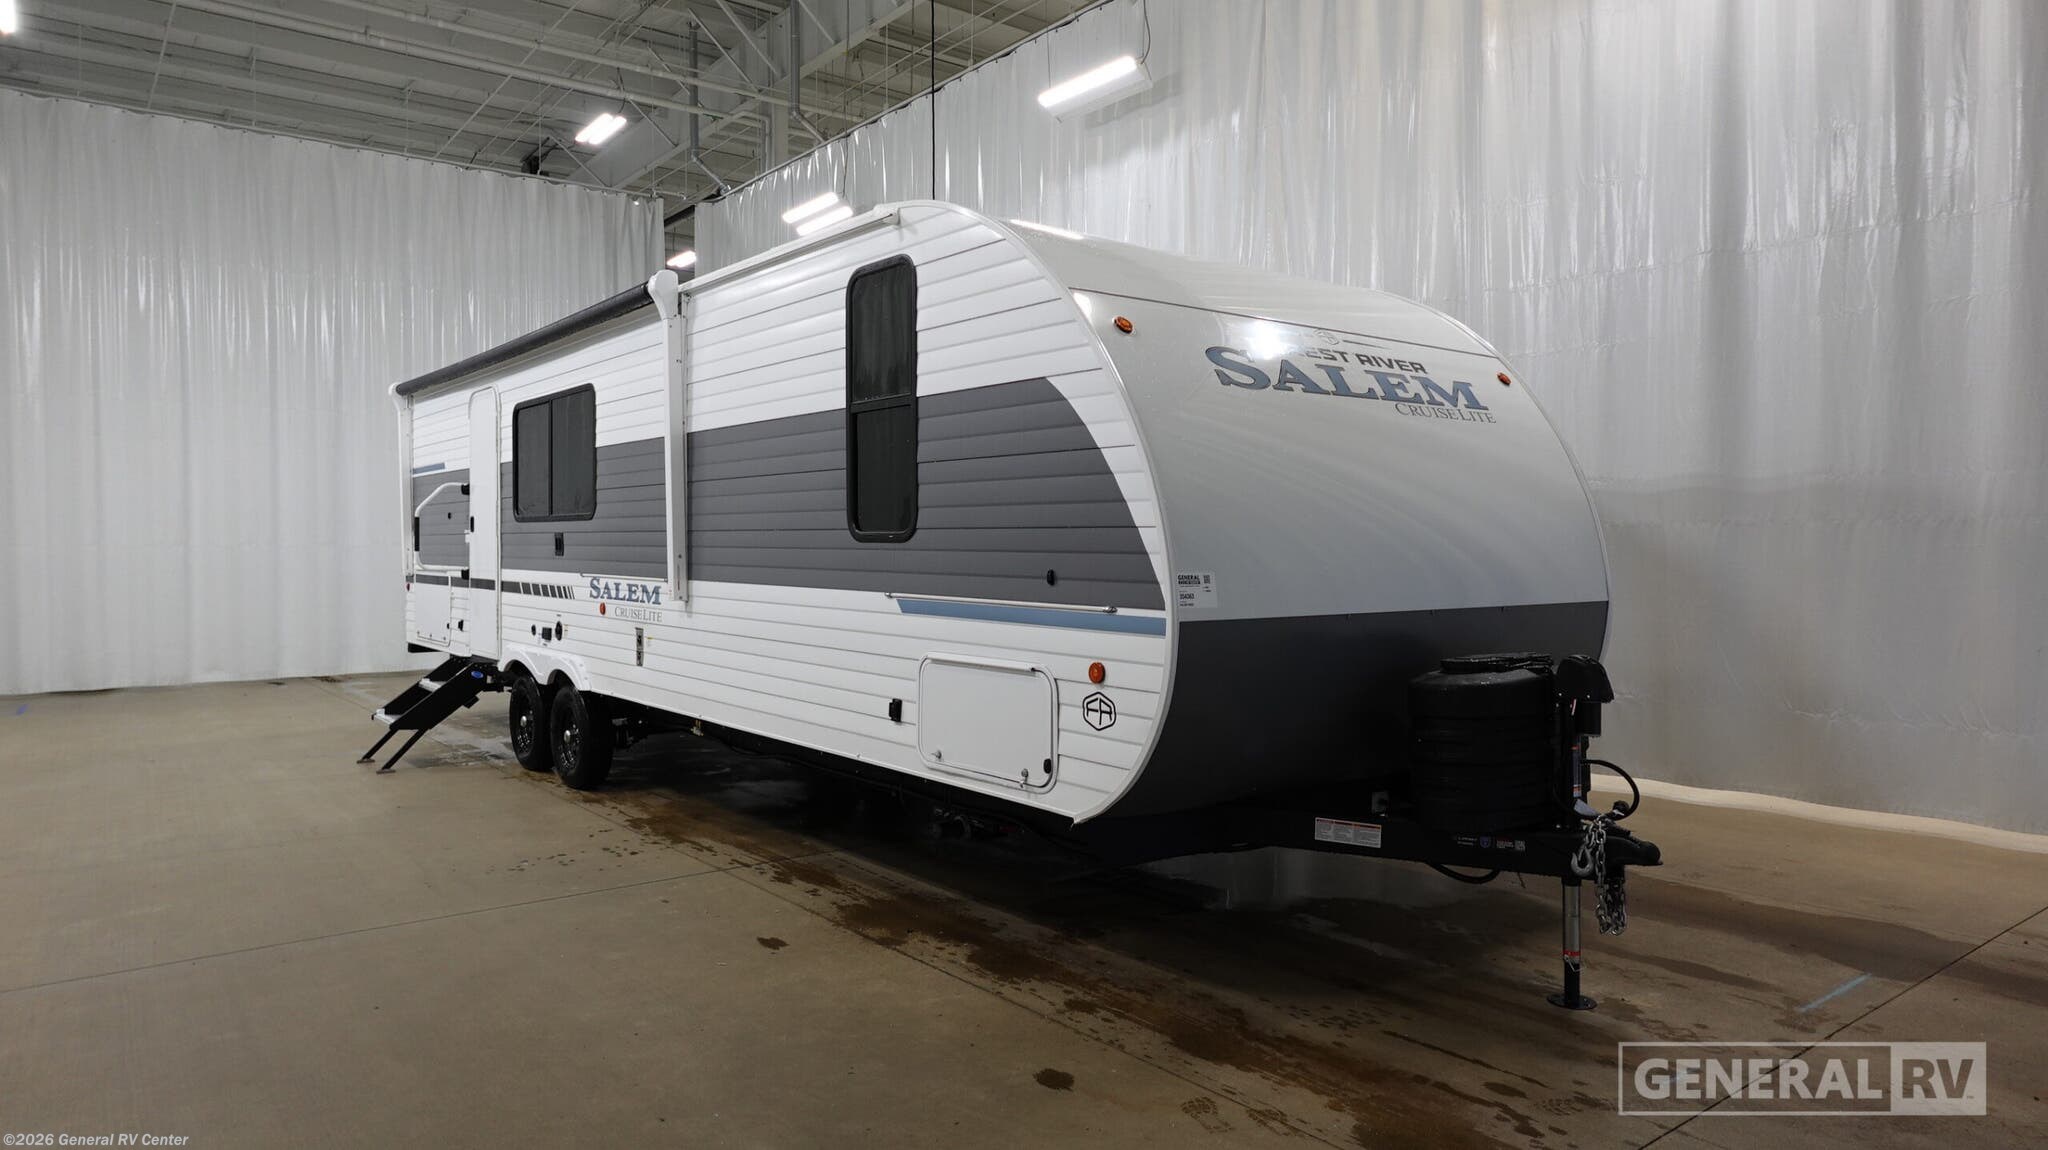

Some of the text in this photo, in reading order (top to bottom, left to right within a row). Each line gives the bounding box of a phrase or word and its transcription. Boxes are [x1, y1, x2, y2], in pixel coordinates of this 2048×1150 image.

[1205, 346, 1489, 411] SALEM
[1356, 353, 1428, 375] RIVER
[589, 576, 662, 605] SALEM
